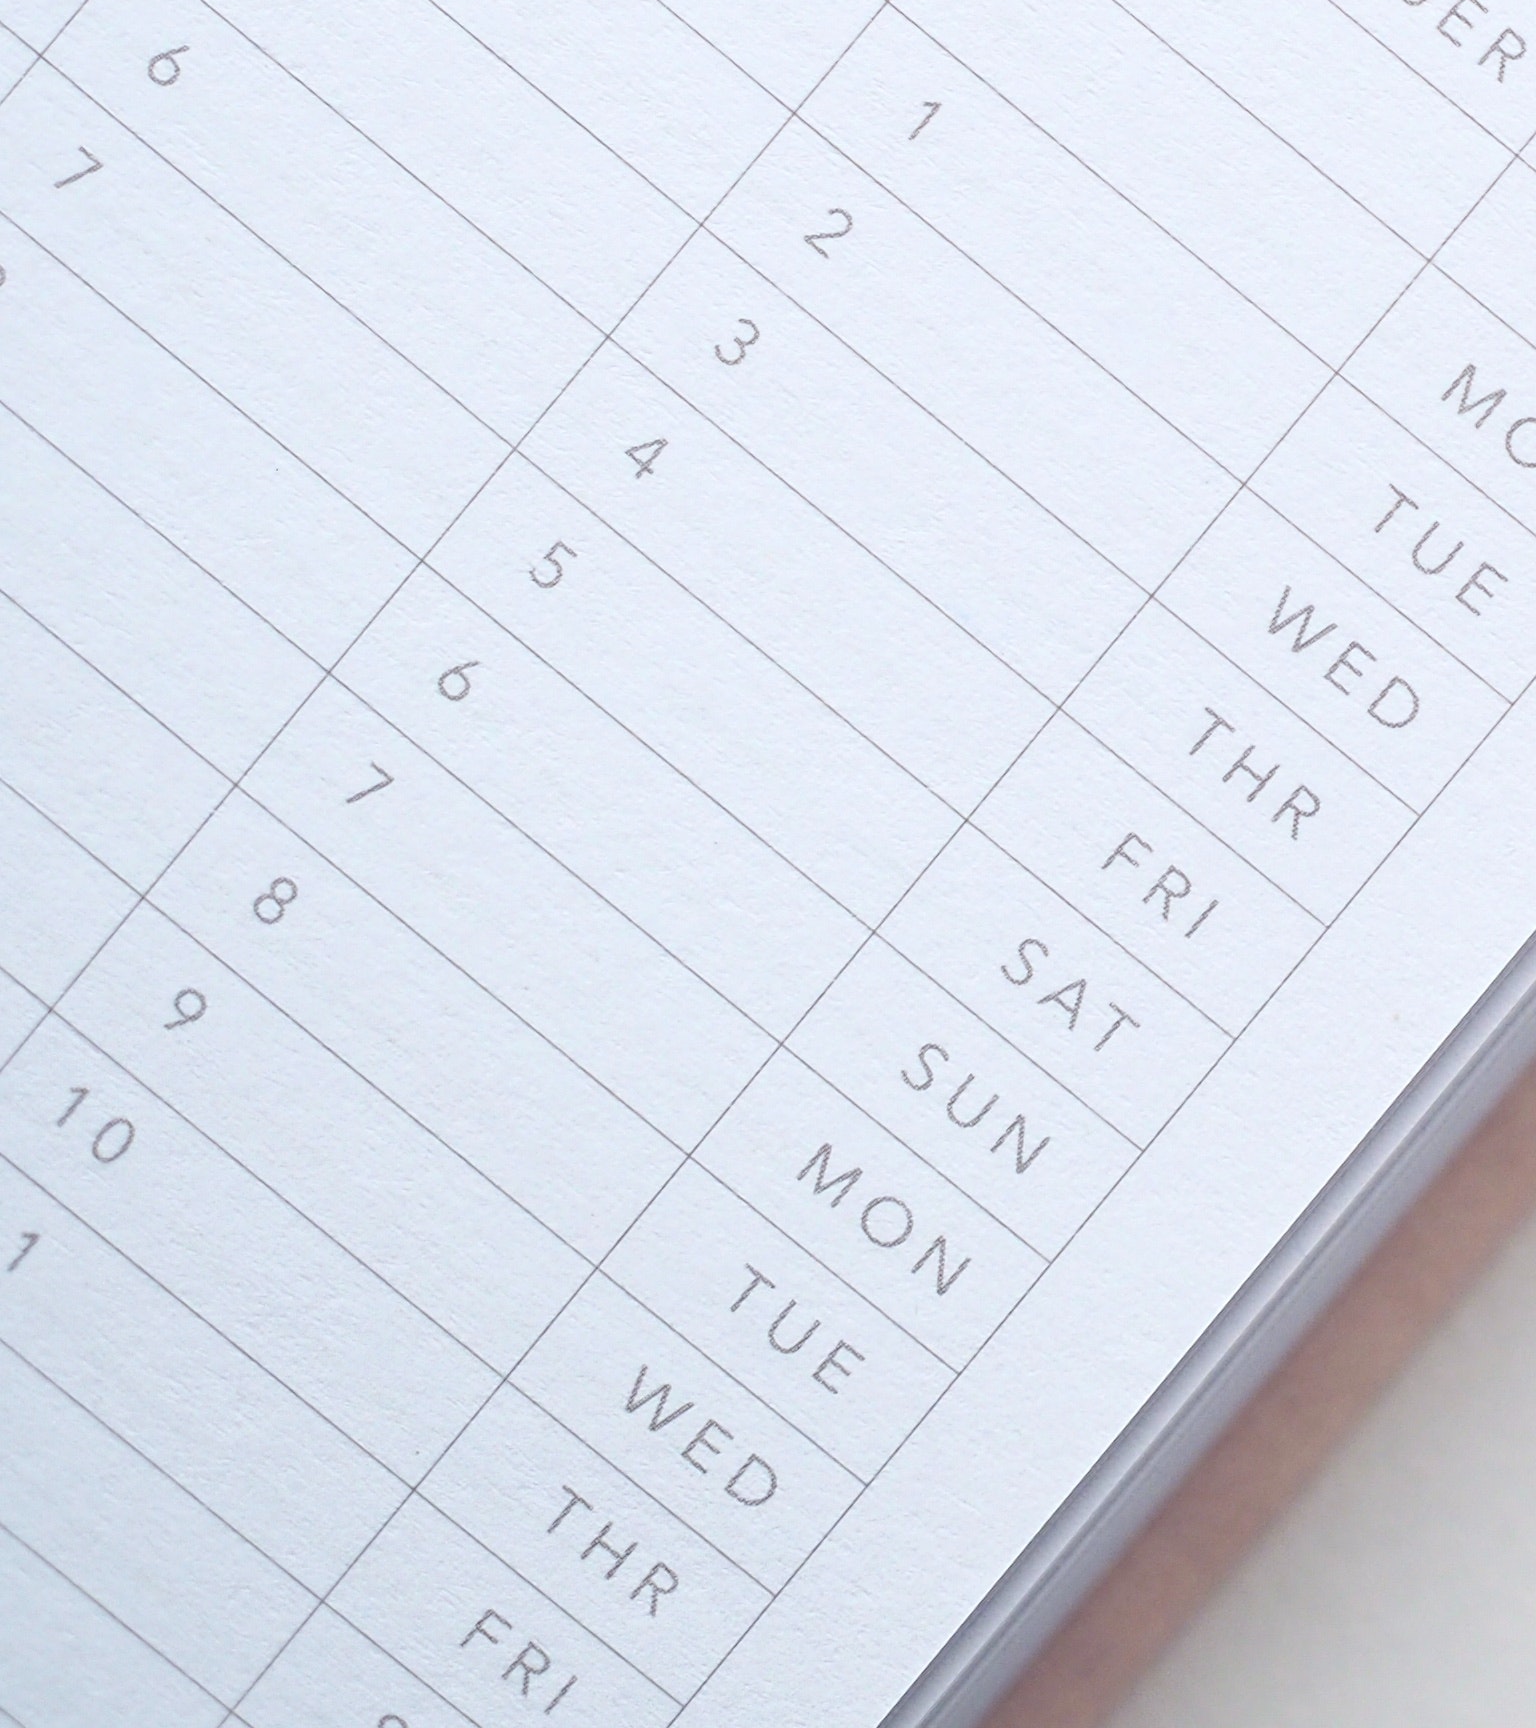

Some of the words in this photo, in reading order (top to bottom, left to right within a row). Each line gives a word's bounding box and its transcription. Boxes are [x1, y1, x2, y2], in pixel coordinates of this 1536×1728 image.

[147, 45, 189, 87] 6
[908, 101, 942, 141] 1
[54, 146, 103, 189] 7
[803, 207, 853, 259] 2
[714, 318, 760, 366] 3
[624, 438, 668, 479] 4
[528, 540, 577, 589] 5
[1374, 484, 1508, 616] TUE
[437, 660, 480, 702] 6
[1267, 586, 1420, 729] WED
[345, 762, 394, 804] 7
[1189, 706, 1321, 841] THR
[252, 876, 298, 926] 8
[1101, 832, 1219, 939] FRI
[163, 987, 208, 1030] 9
[1000, 938, 1141, 1052] SAT
[56, 1086, 135, 1165] 10
[900, 1042, 1051, 1175] SUN
[796, 1142, 971, 1296] MON
[729, 1263, 865, 1395] TUE
[624, 1365, 778, 1507] WED
[546, 1485, 679, 1617] THR
[459, 1608, 577, 1715] FRI
